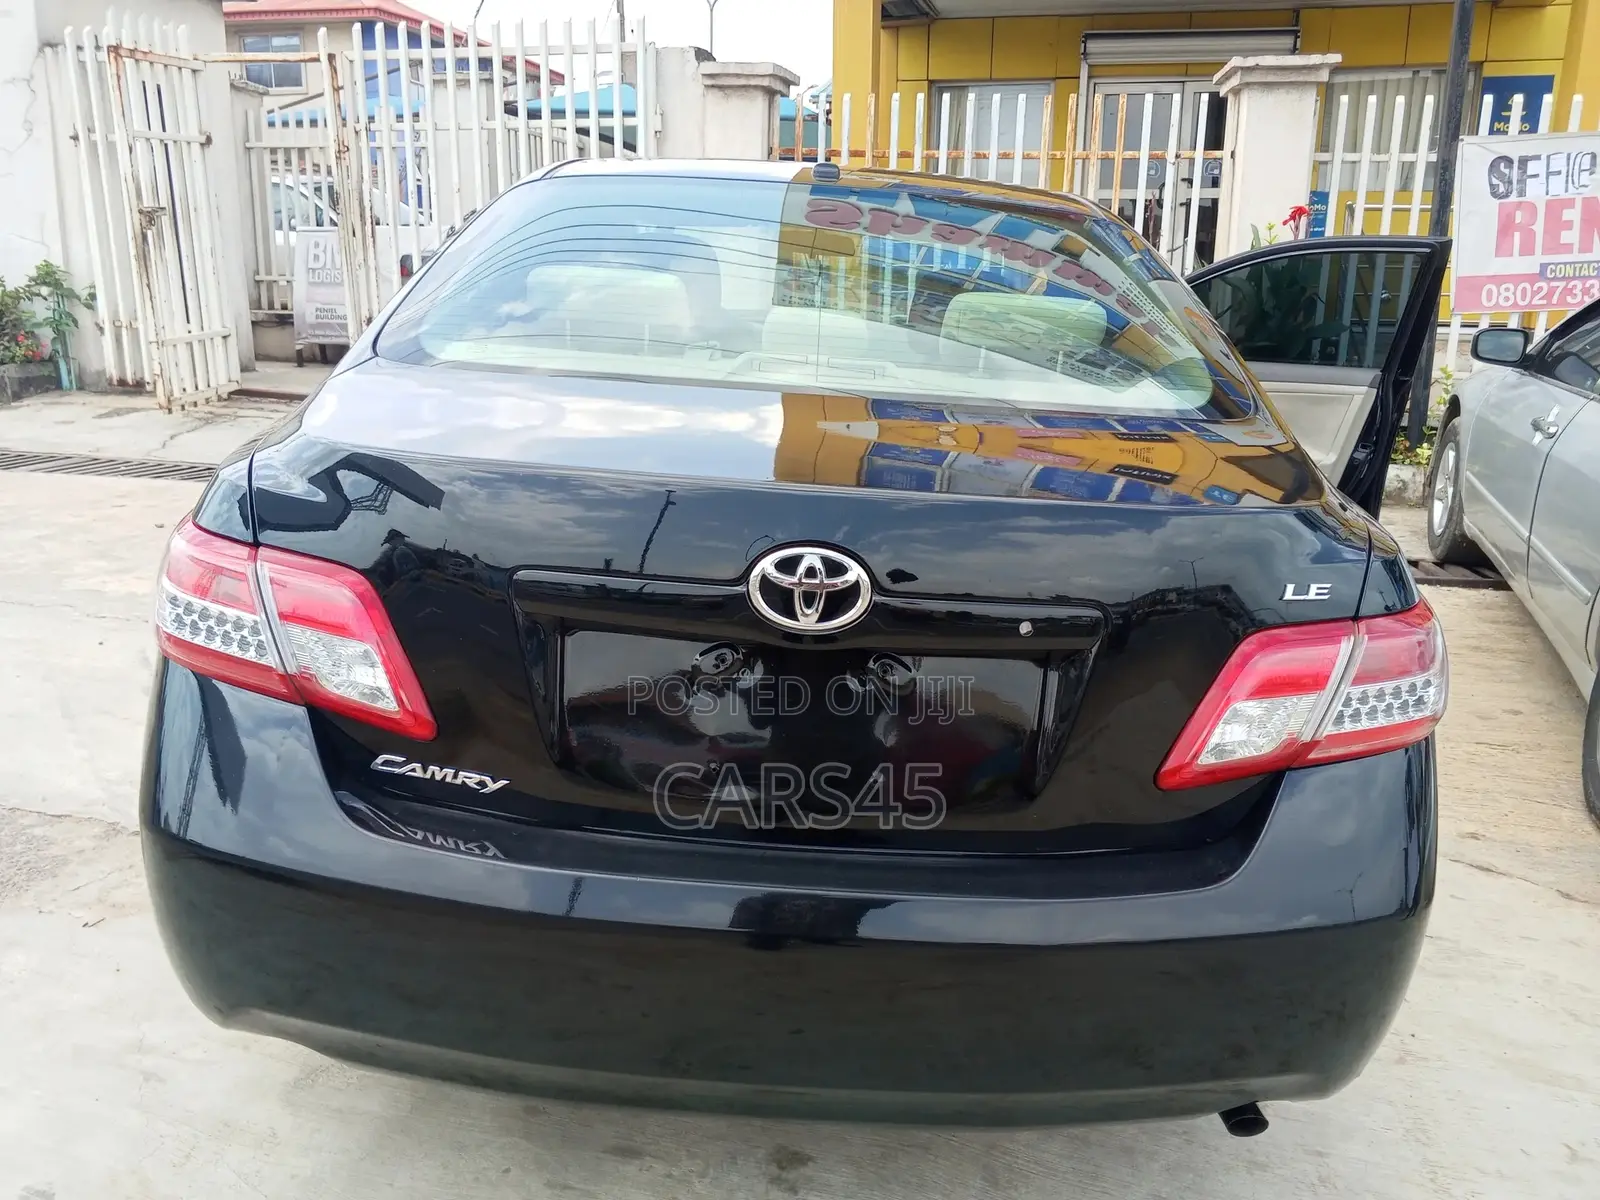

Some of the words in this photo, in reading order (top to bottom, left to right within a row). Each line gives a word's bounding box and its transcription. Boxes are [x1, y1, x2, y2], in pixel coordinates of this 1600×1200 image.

[1493, 121, 1530, 132] Moo
[1279, 583, 1333, 601] LE
[370, 754, 510, 793] CAMRY
